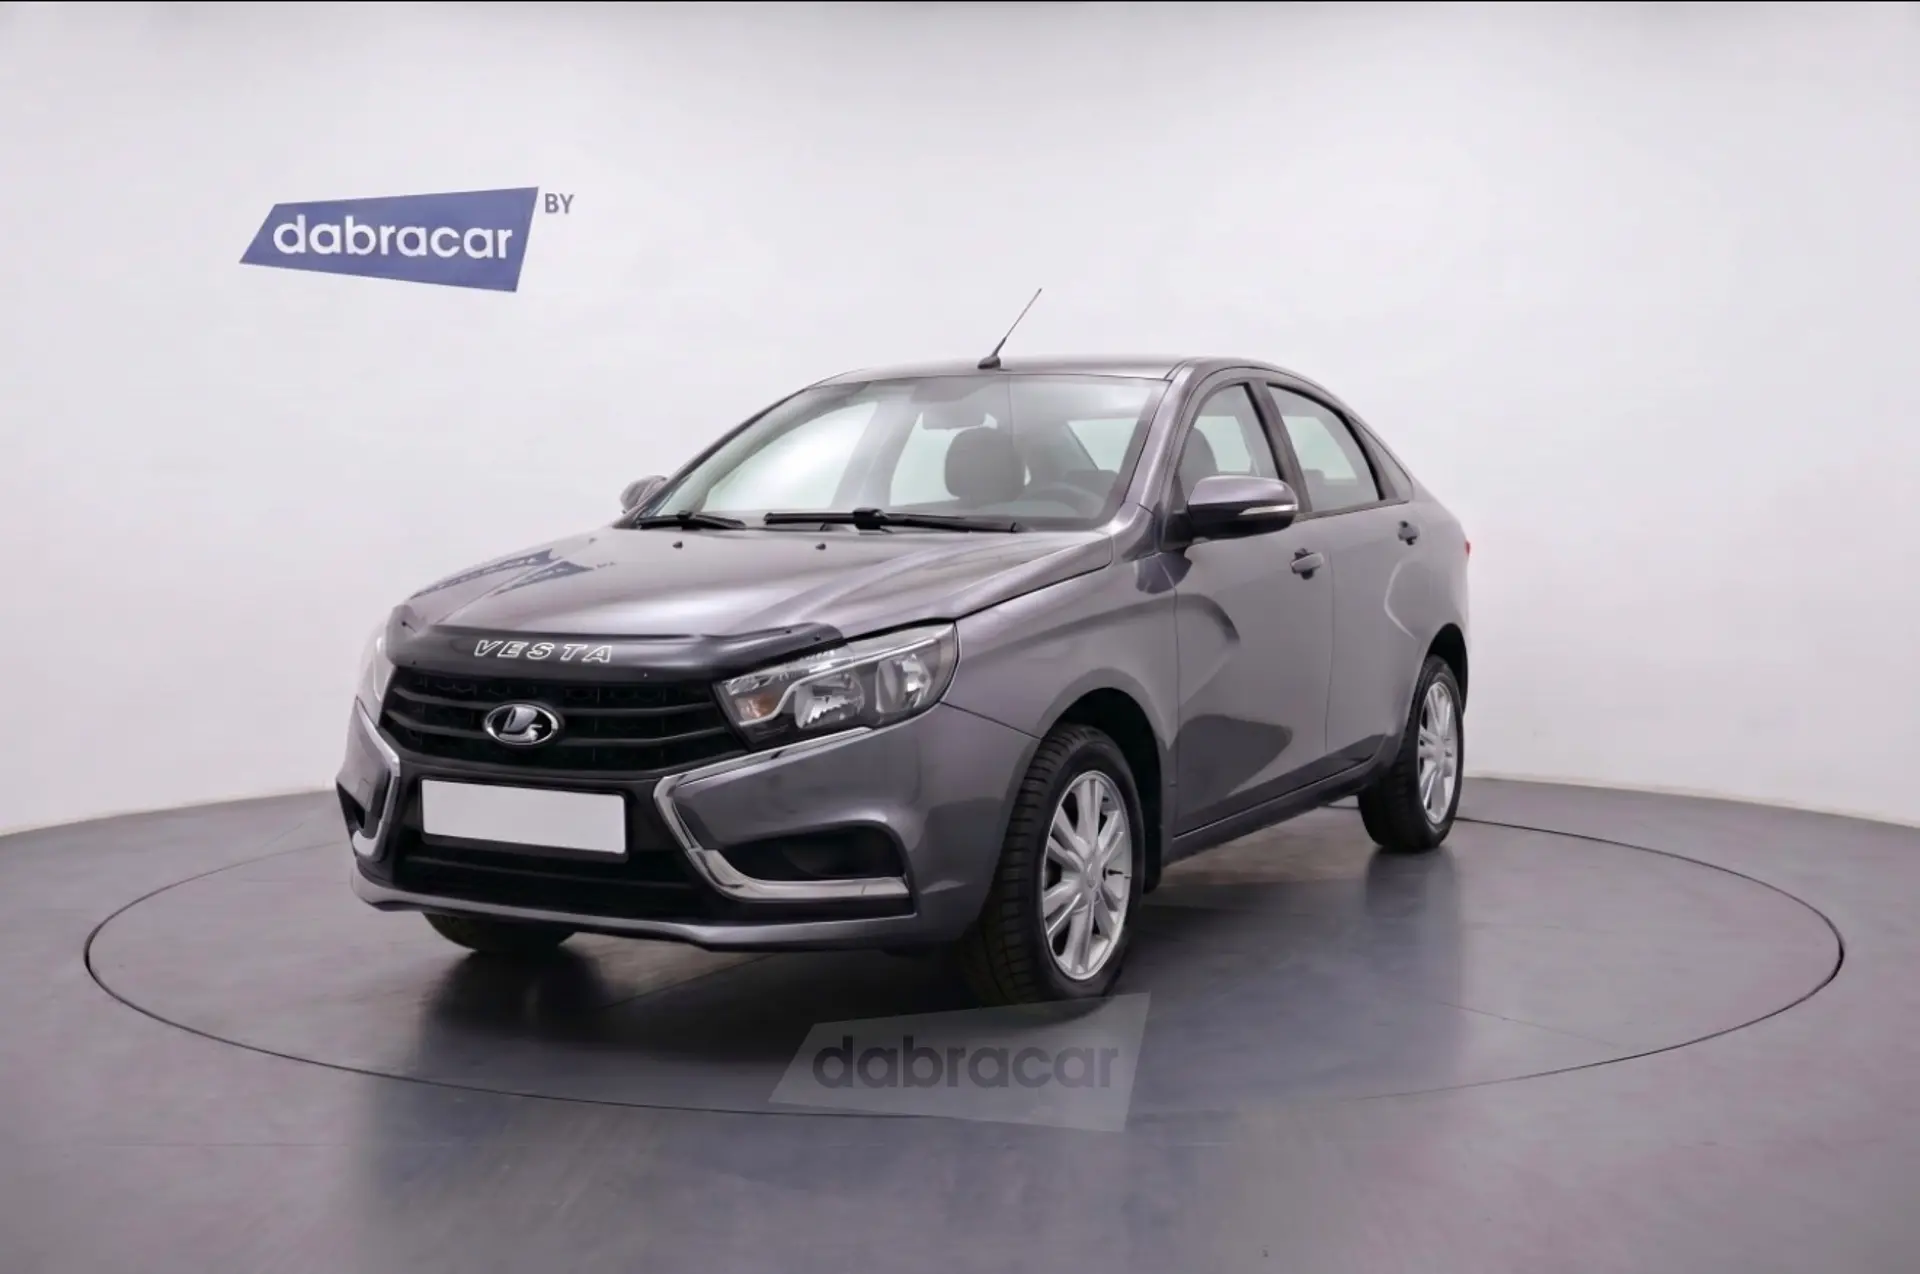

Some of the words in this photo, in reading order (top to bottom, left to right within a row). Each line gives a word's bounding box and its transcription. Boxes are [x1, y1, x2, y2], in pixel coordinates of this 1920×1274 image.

[273, 215, 513, 259] dabracar
[545, 194, 574, 214] BY
[474, 640, 612, 663] VESTA
